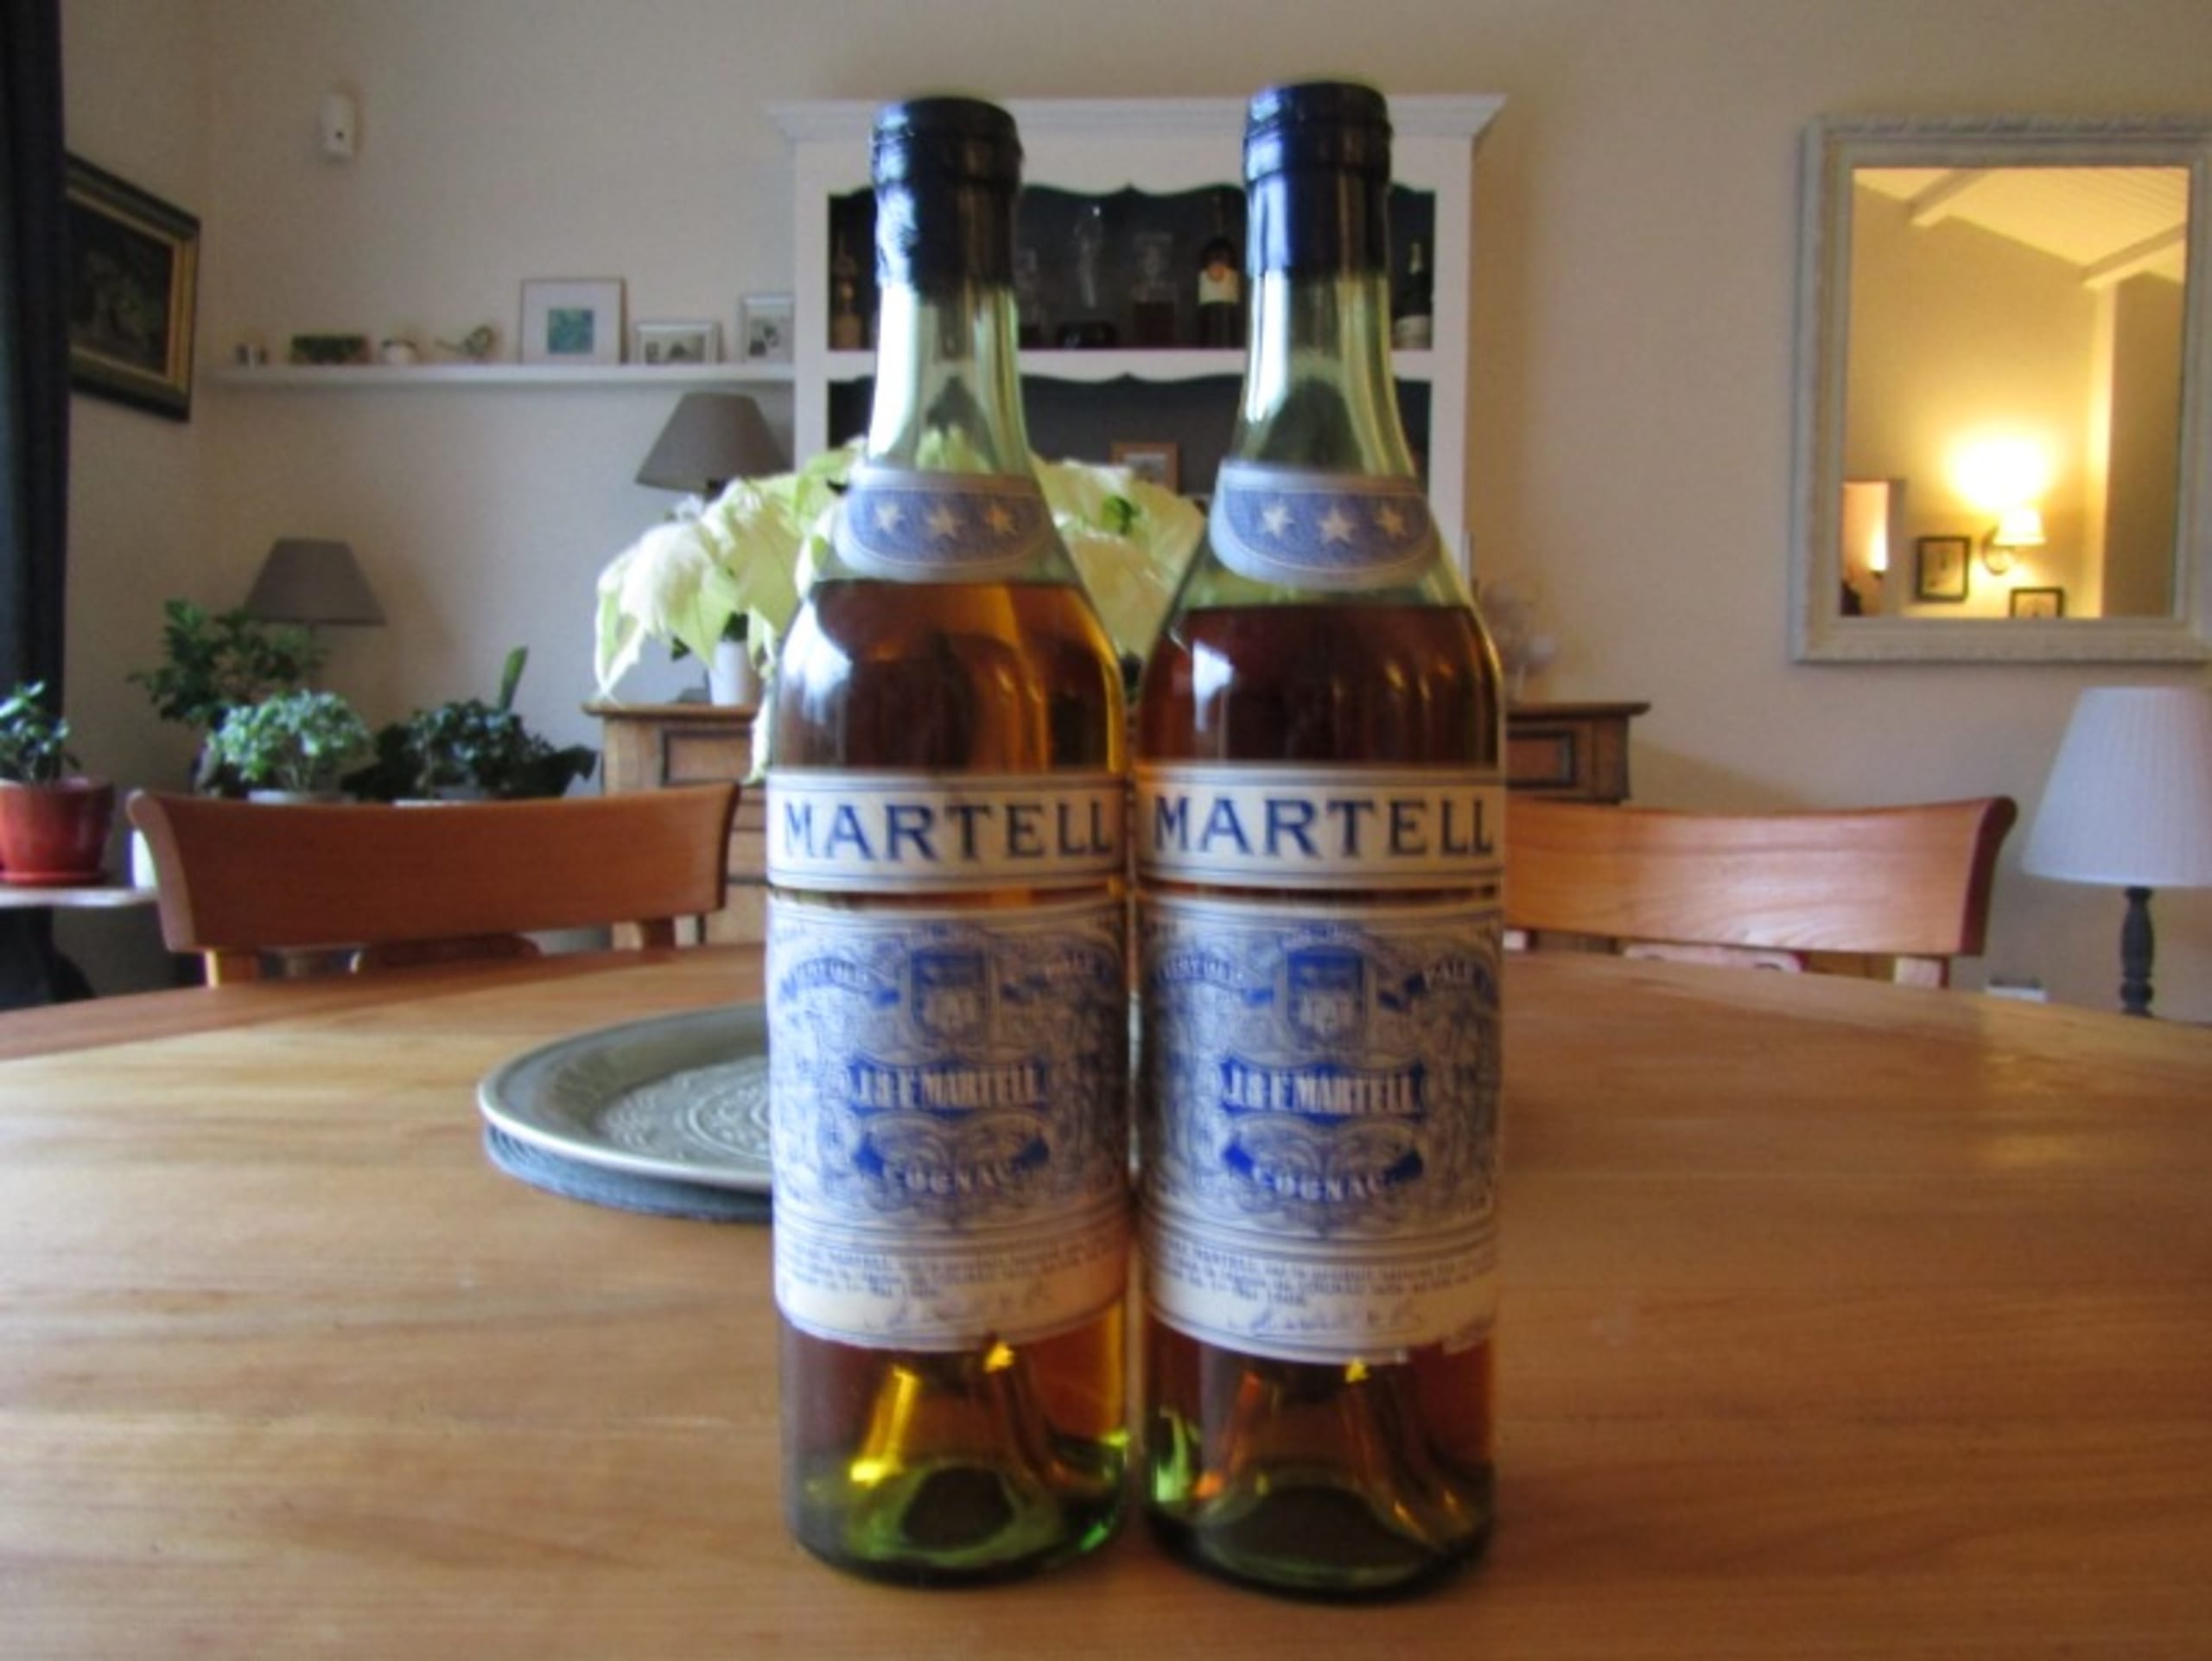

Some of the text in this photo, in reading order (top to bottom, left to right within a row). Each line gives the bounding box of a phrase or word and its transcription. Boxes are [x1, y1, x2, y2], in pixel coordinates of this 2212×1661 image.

[783, 800, 1112, 862] MARTELL
[1154, 796, 1494, 857] MARTELL
[1294, 1070, 1423, 1114] MARTELL
